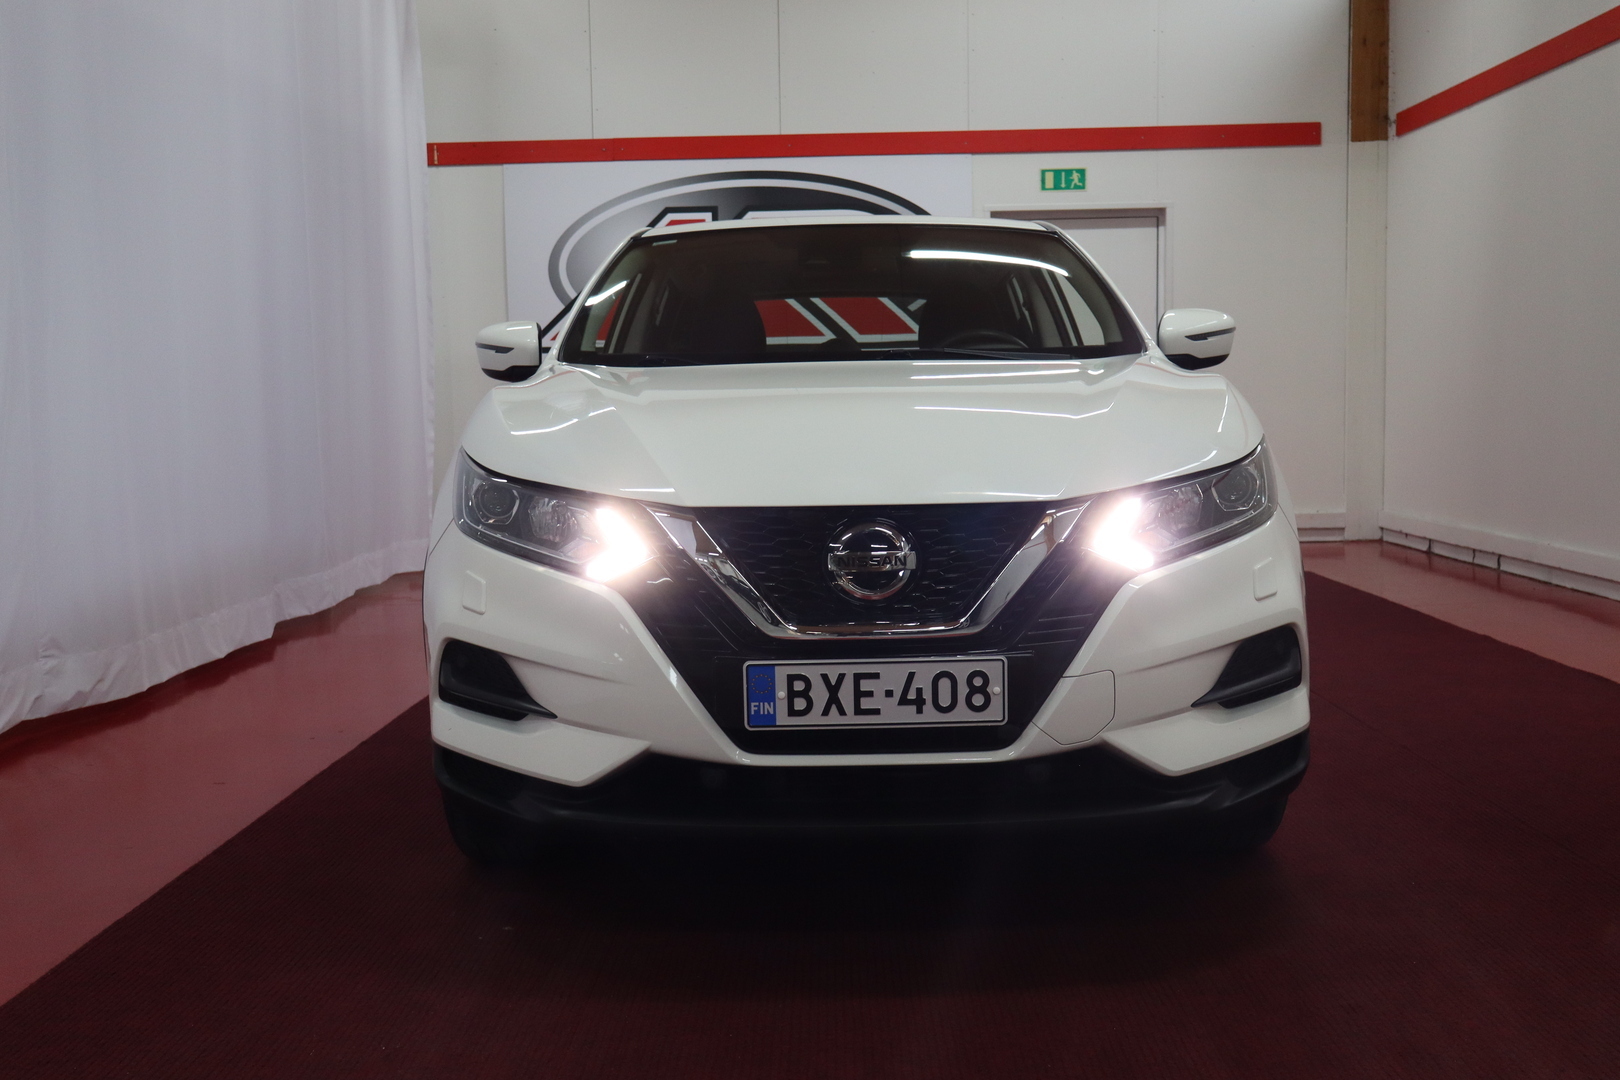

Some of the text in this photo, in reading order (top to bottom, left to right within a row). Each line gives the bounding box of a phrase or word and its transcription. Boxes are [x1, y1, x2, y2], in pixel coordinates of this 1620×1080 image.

[836, 555, 907, 567] NISSAN
[786, 669, 992, 717] BXE-408
[750, 701, 774, 715] FIN
